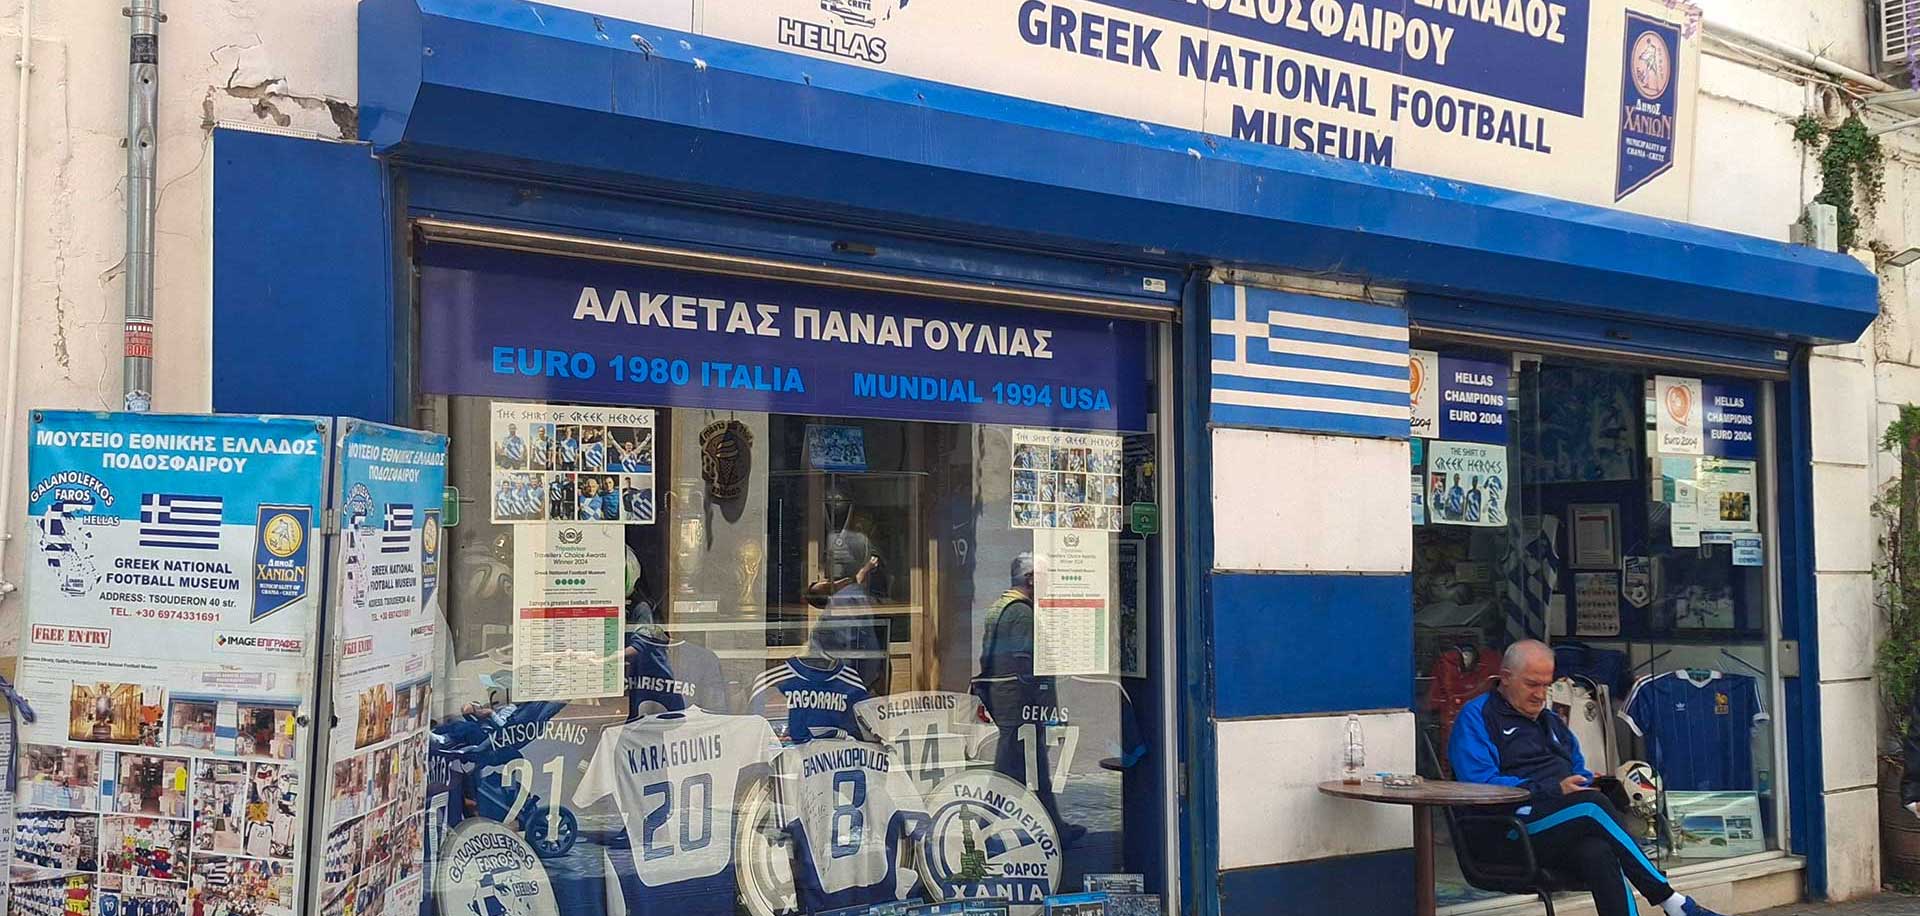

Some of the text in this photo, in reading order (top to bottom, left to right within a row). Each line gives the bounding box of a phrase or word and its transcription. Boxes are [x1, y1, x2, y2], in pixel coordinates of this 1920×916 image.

[778, 17, 887, 64] HELLAS
[1018, 0, 1552, 154] GREEK NATIONAL FOOTBALL
[1232, 105, 1394, 169] MUSEUM
[573, 287, 1053, 359] ΑΛΚΕΤΑΣ ΠΑΝΑΓΟΥΛΙΑΣ
[492, 346, 804, 392] EURO 1980 ITALIA
[1455, 372, 1494, 387] HELLAS
[854, 372, 1111, 411] MUNDIAL 1994 USA
[1444, 390, 1504, 407] CHAMPIONS
[1714, 396, 1744, 408] HELLAS
[496, 409, 649, 425] THE SHIRT OF GREEK HEROES
[1449, 409, 1503, 425] EURO 2004
[1707, 412, 1753, 426] CHAMPIONS
[37, 430, 317, 456] ΜΟΥΣΕΙΟ ΕΘΝΙΚΗΣ ΕΛΛΑΔΟΣ
[1664, 433, 1680, 445] Euro
[1711, 429, 1753, 441] EURO 2004
[348, 442, 379, 460] ΜΟΥΣΕΙΟ
[1451, 447, 1487, 457] THE SHIRT OF
[102, 452, 248, 474] ΠΟΔΟΣΦΑΙΡΟΥ
[1435, 457, 1502, 474] GREEK HEROES
[30, 471, 115, 507] GALANOLEFKOS
[55, 488, 90, 502] FAROS
[83, 514, 120, 527] HELLAS
[114, 557, 233, 575] GREEK NATIONAL
[106, 573, 240, 591] FOOTBALL MUSEUM
[99, 591, 237, 608] ADDRESS: TSOUDERON 40 str.
[110, 606, 220, 622] TEL. +30 6974331691
[35, 627, 108, 645] FREE ENTRY
[228, 637, 256, 646] IMAGE
[624, 676, 696, 697] CHARISTEAS
[785, 690, 848, 713] ZAGORAKIS
[877, 694, 955, 721] SALPINGIDIS
[1022, 704, 1069, 722] GEKAS
[489, 720, 588, 751] KATSOURANIS
[628, 734, 721, 775] KARAGOUNIS
[895, 723, 945, 789] 14
[1017, 723, 1080, 794] 17
[501, 755, 564, 842] 21
[643, 772, 712, 862] 20
[831, 769, 867, 860] 8
[953, 784, 1058, 860] ΓΑΛΑΝΟΛΕΥΚΟΣ
[449, 832, 535, 883] GALANOLEFKOS
[475, 851, 516, 873] FAROS
[1003, 862, 1048, 878] ΦΑΡΟΣ
